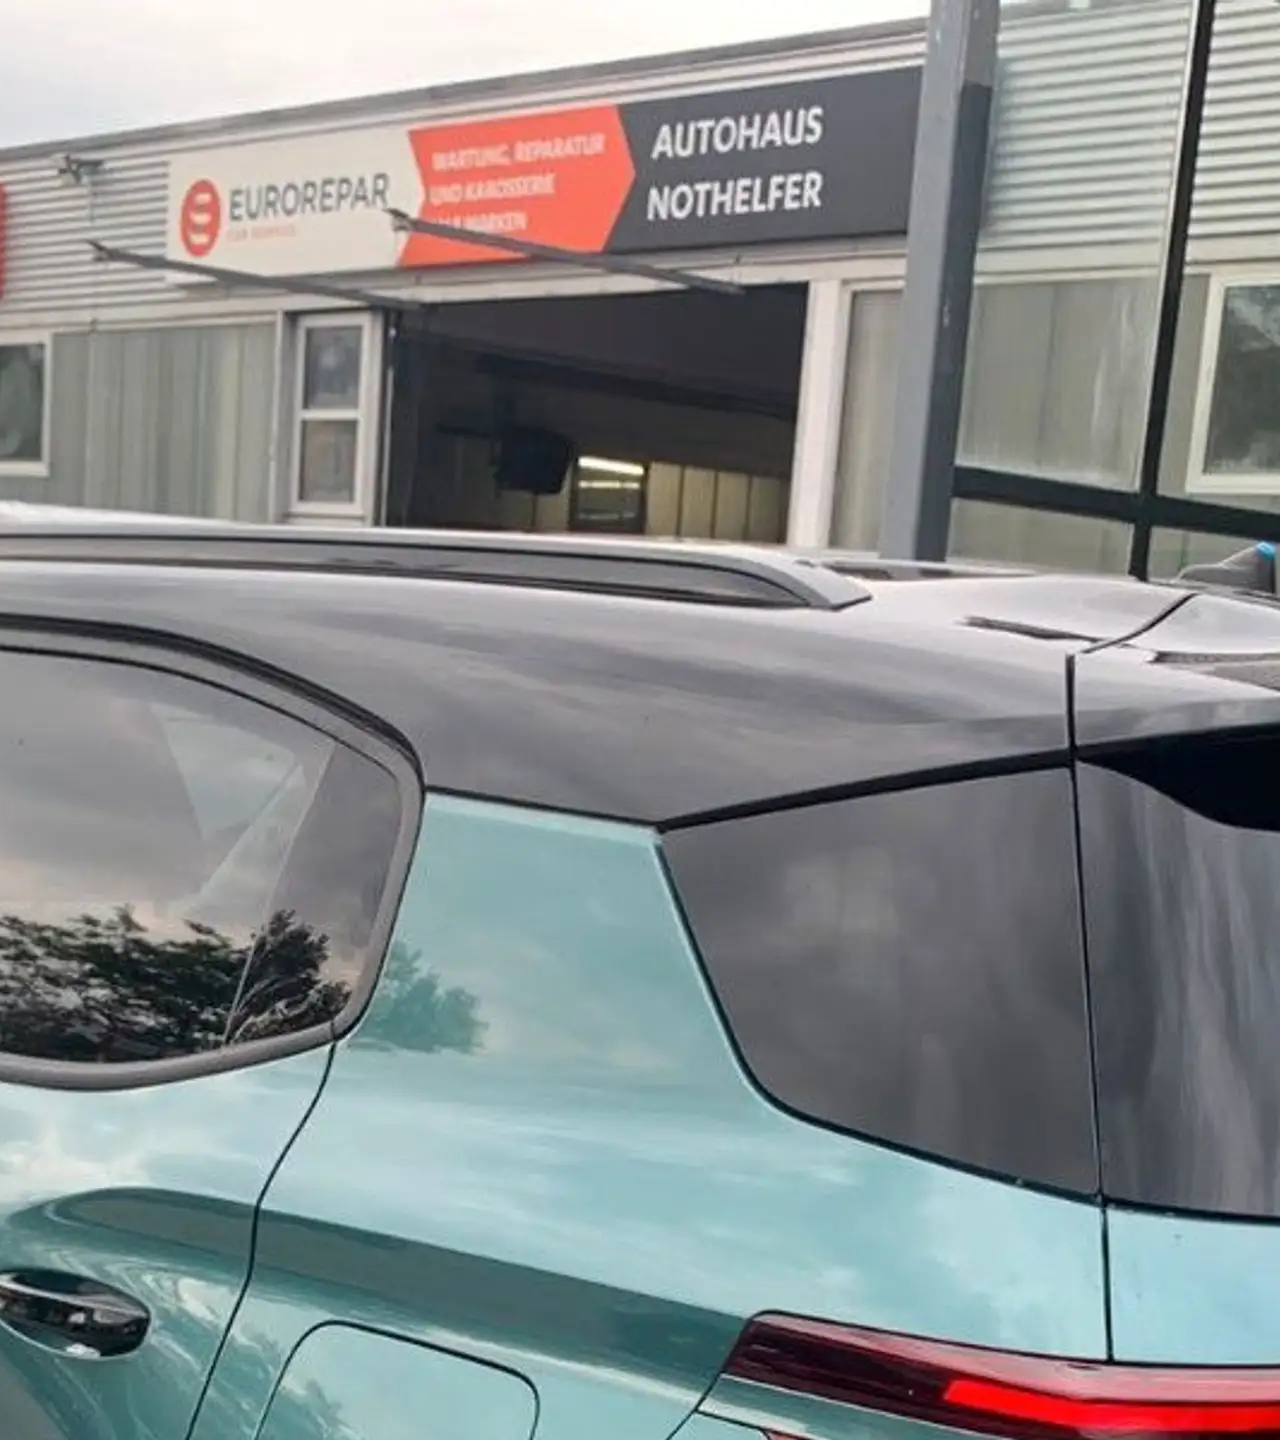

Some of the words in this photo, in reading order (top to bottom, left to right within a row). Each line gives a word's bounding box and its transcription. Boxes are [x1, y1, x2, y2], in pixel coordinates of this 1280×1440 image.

[651, 105, 824, 160] AUTOHAUS
[228, 173, 390, 222] EUROREPAR
[646, 171, 824, 221] NOTHELFER
